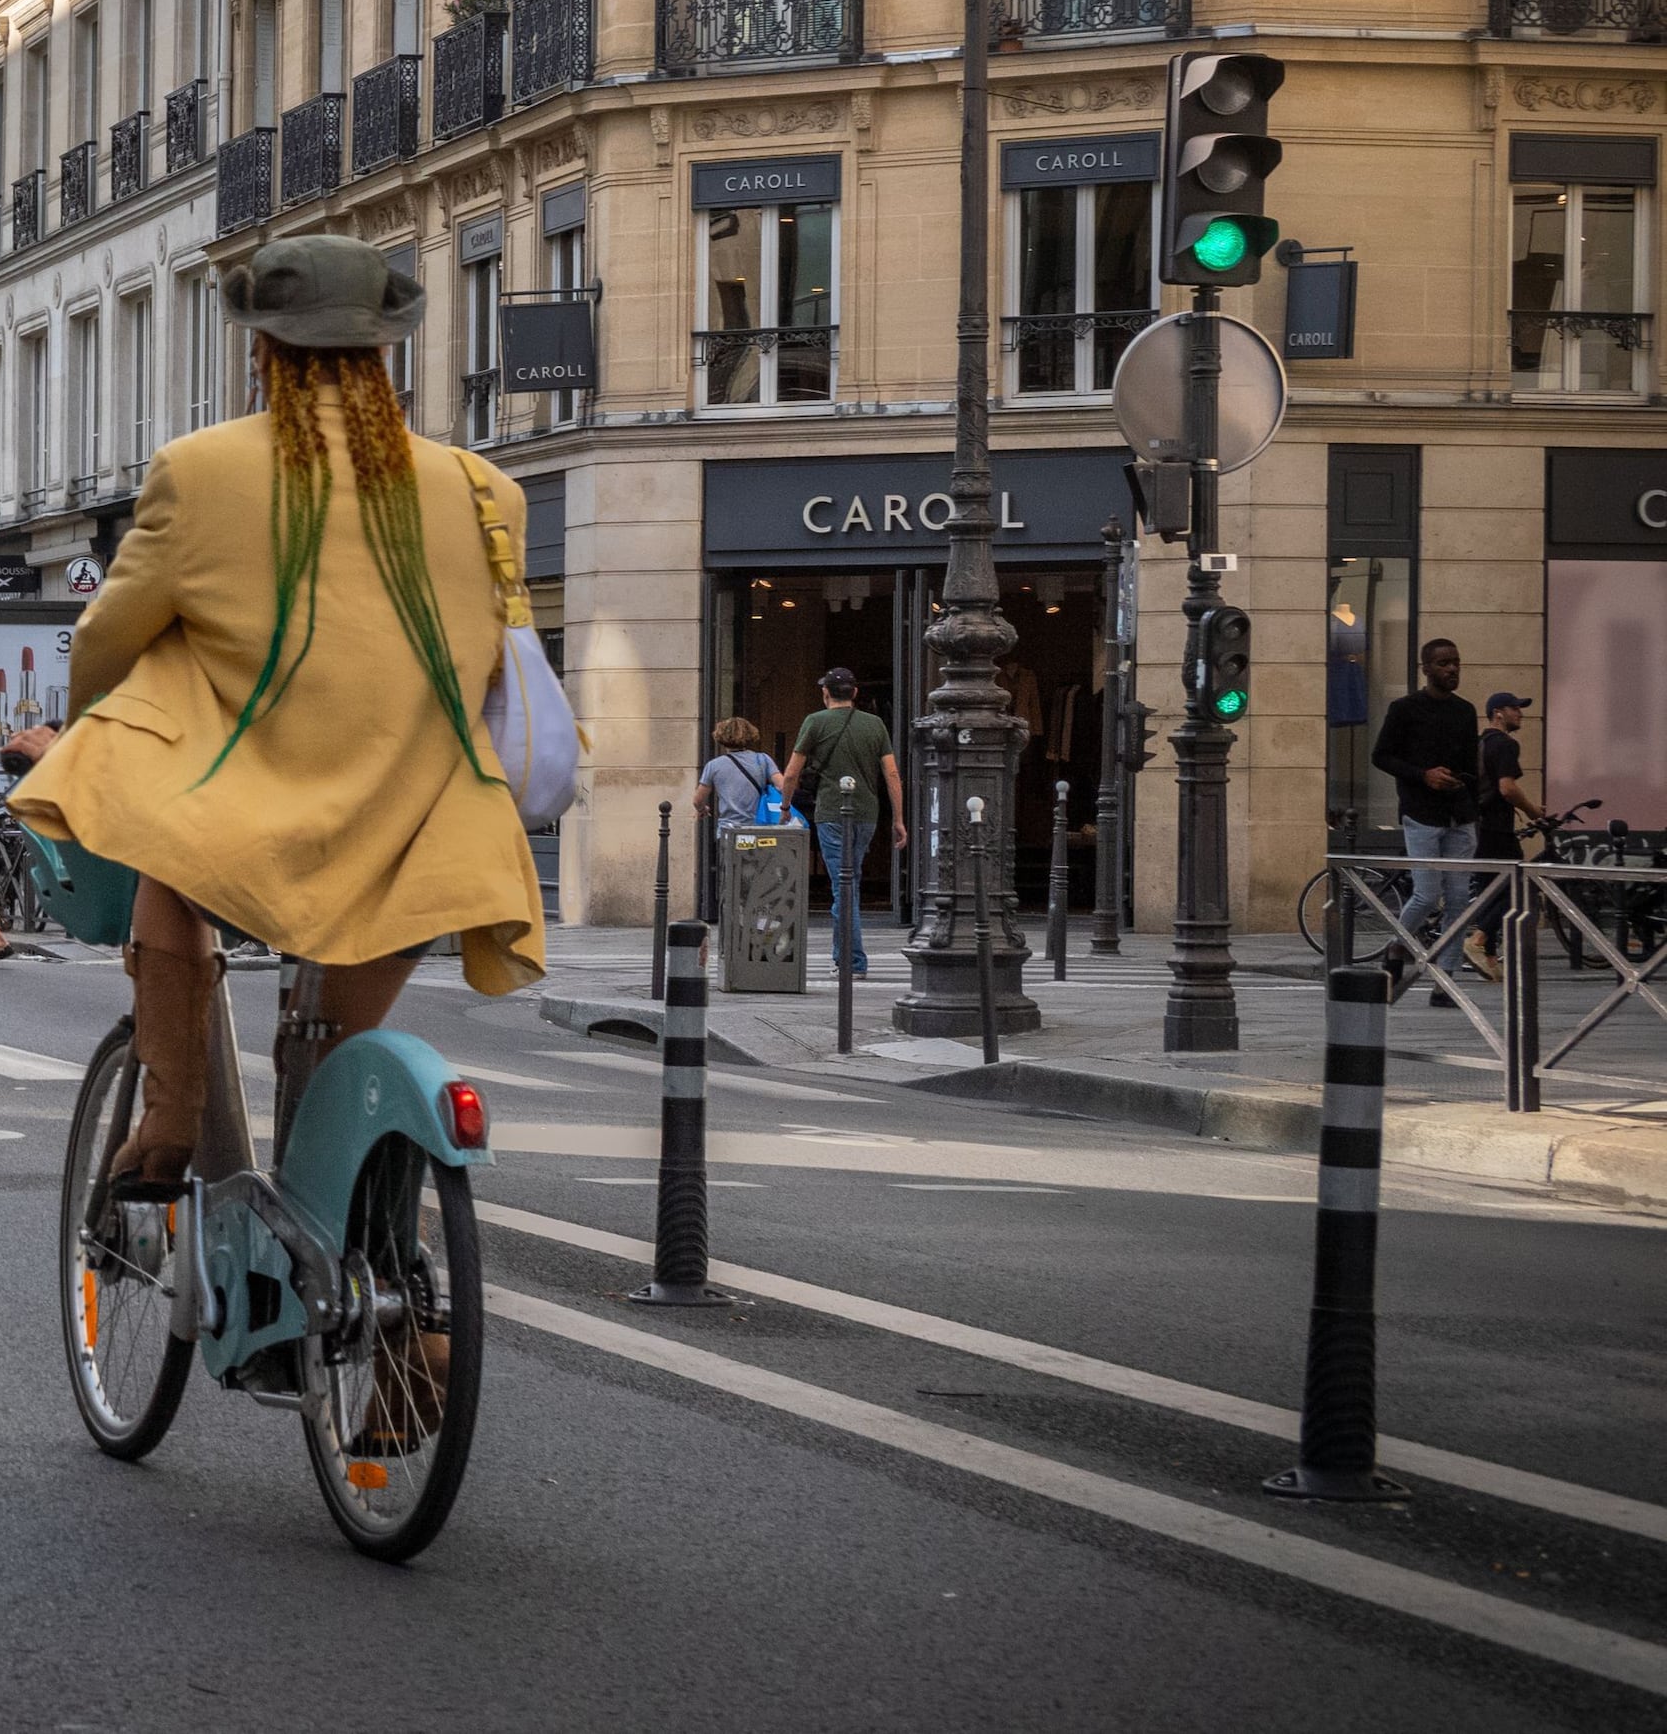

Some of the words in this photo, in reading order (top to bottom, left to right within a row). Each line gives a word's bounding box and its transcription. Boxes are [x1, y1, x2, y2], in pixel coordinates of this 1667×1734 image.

[1035, 151, 1123, 171] CAROLL
[725, 172, 806, 191] CAROLL
[1289, 332, 1334, 346] CAROLL
[516, 364, 586, 380] CAROLL
[802, 491, 1025, 534] CAROL
